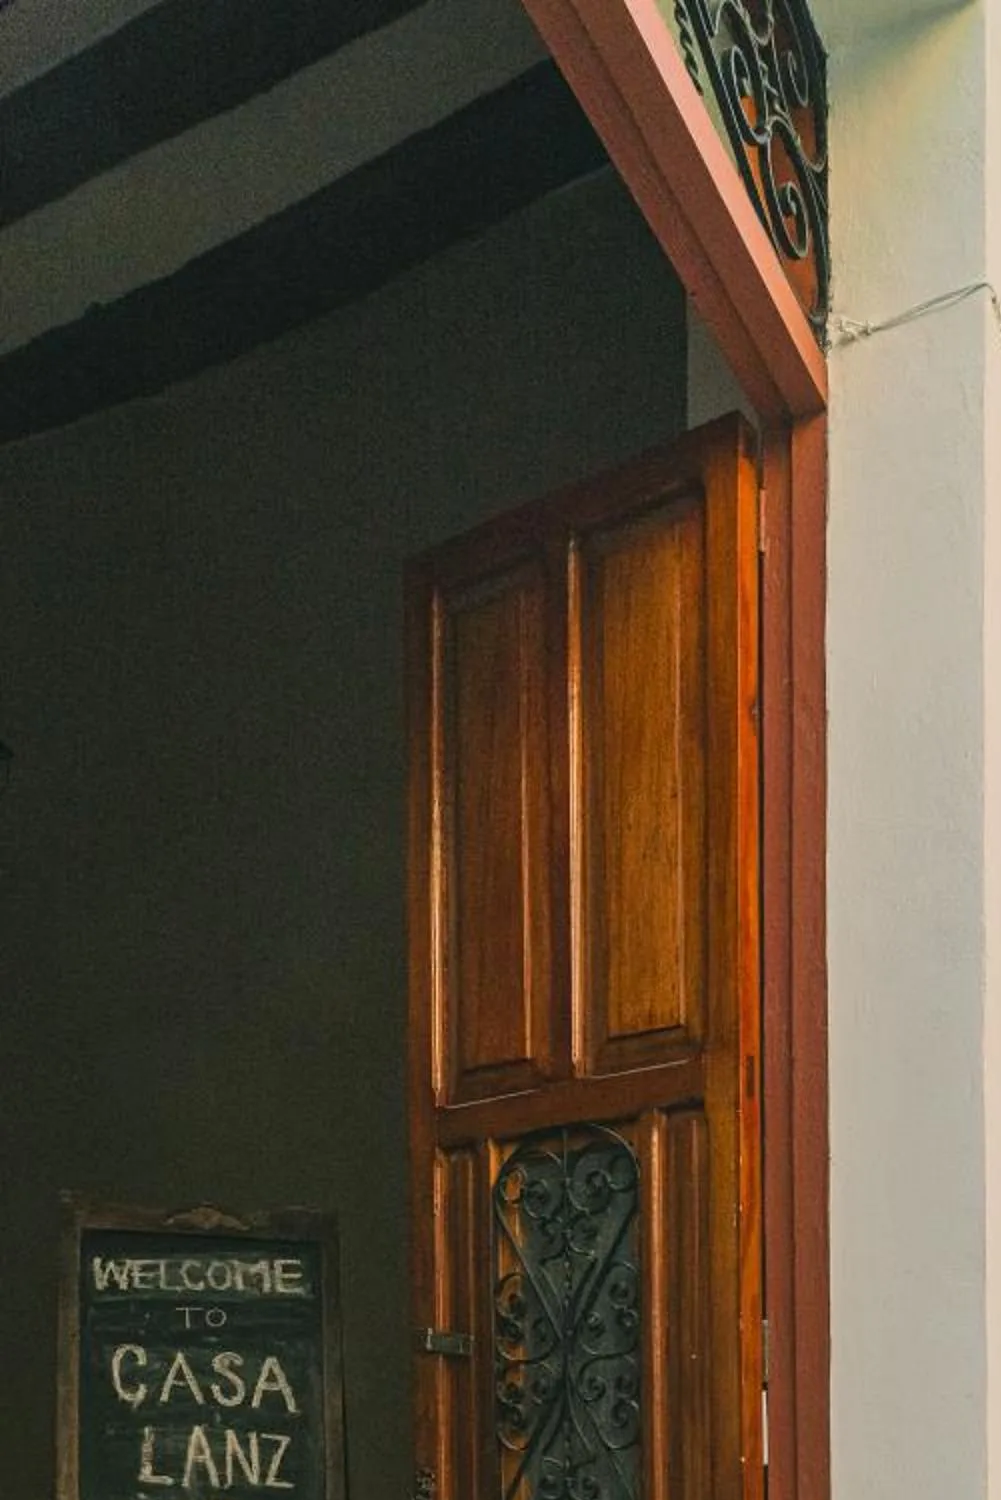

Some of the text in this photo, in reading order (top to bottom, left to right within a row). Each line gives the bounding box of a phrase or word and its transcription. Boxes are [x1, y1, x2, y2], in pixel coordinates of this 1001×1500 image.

[93, 1256, 306, 1294] WELCOME
[175, 1307, 228, 1329] TO
[112, 1344, 300, 1416] CASA
[138, 1426, 295, 1490] LANZ
